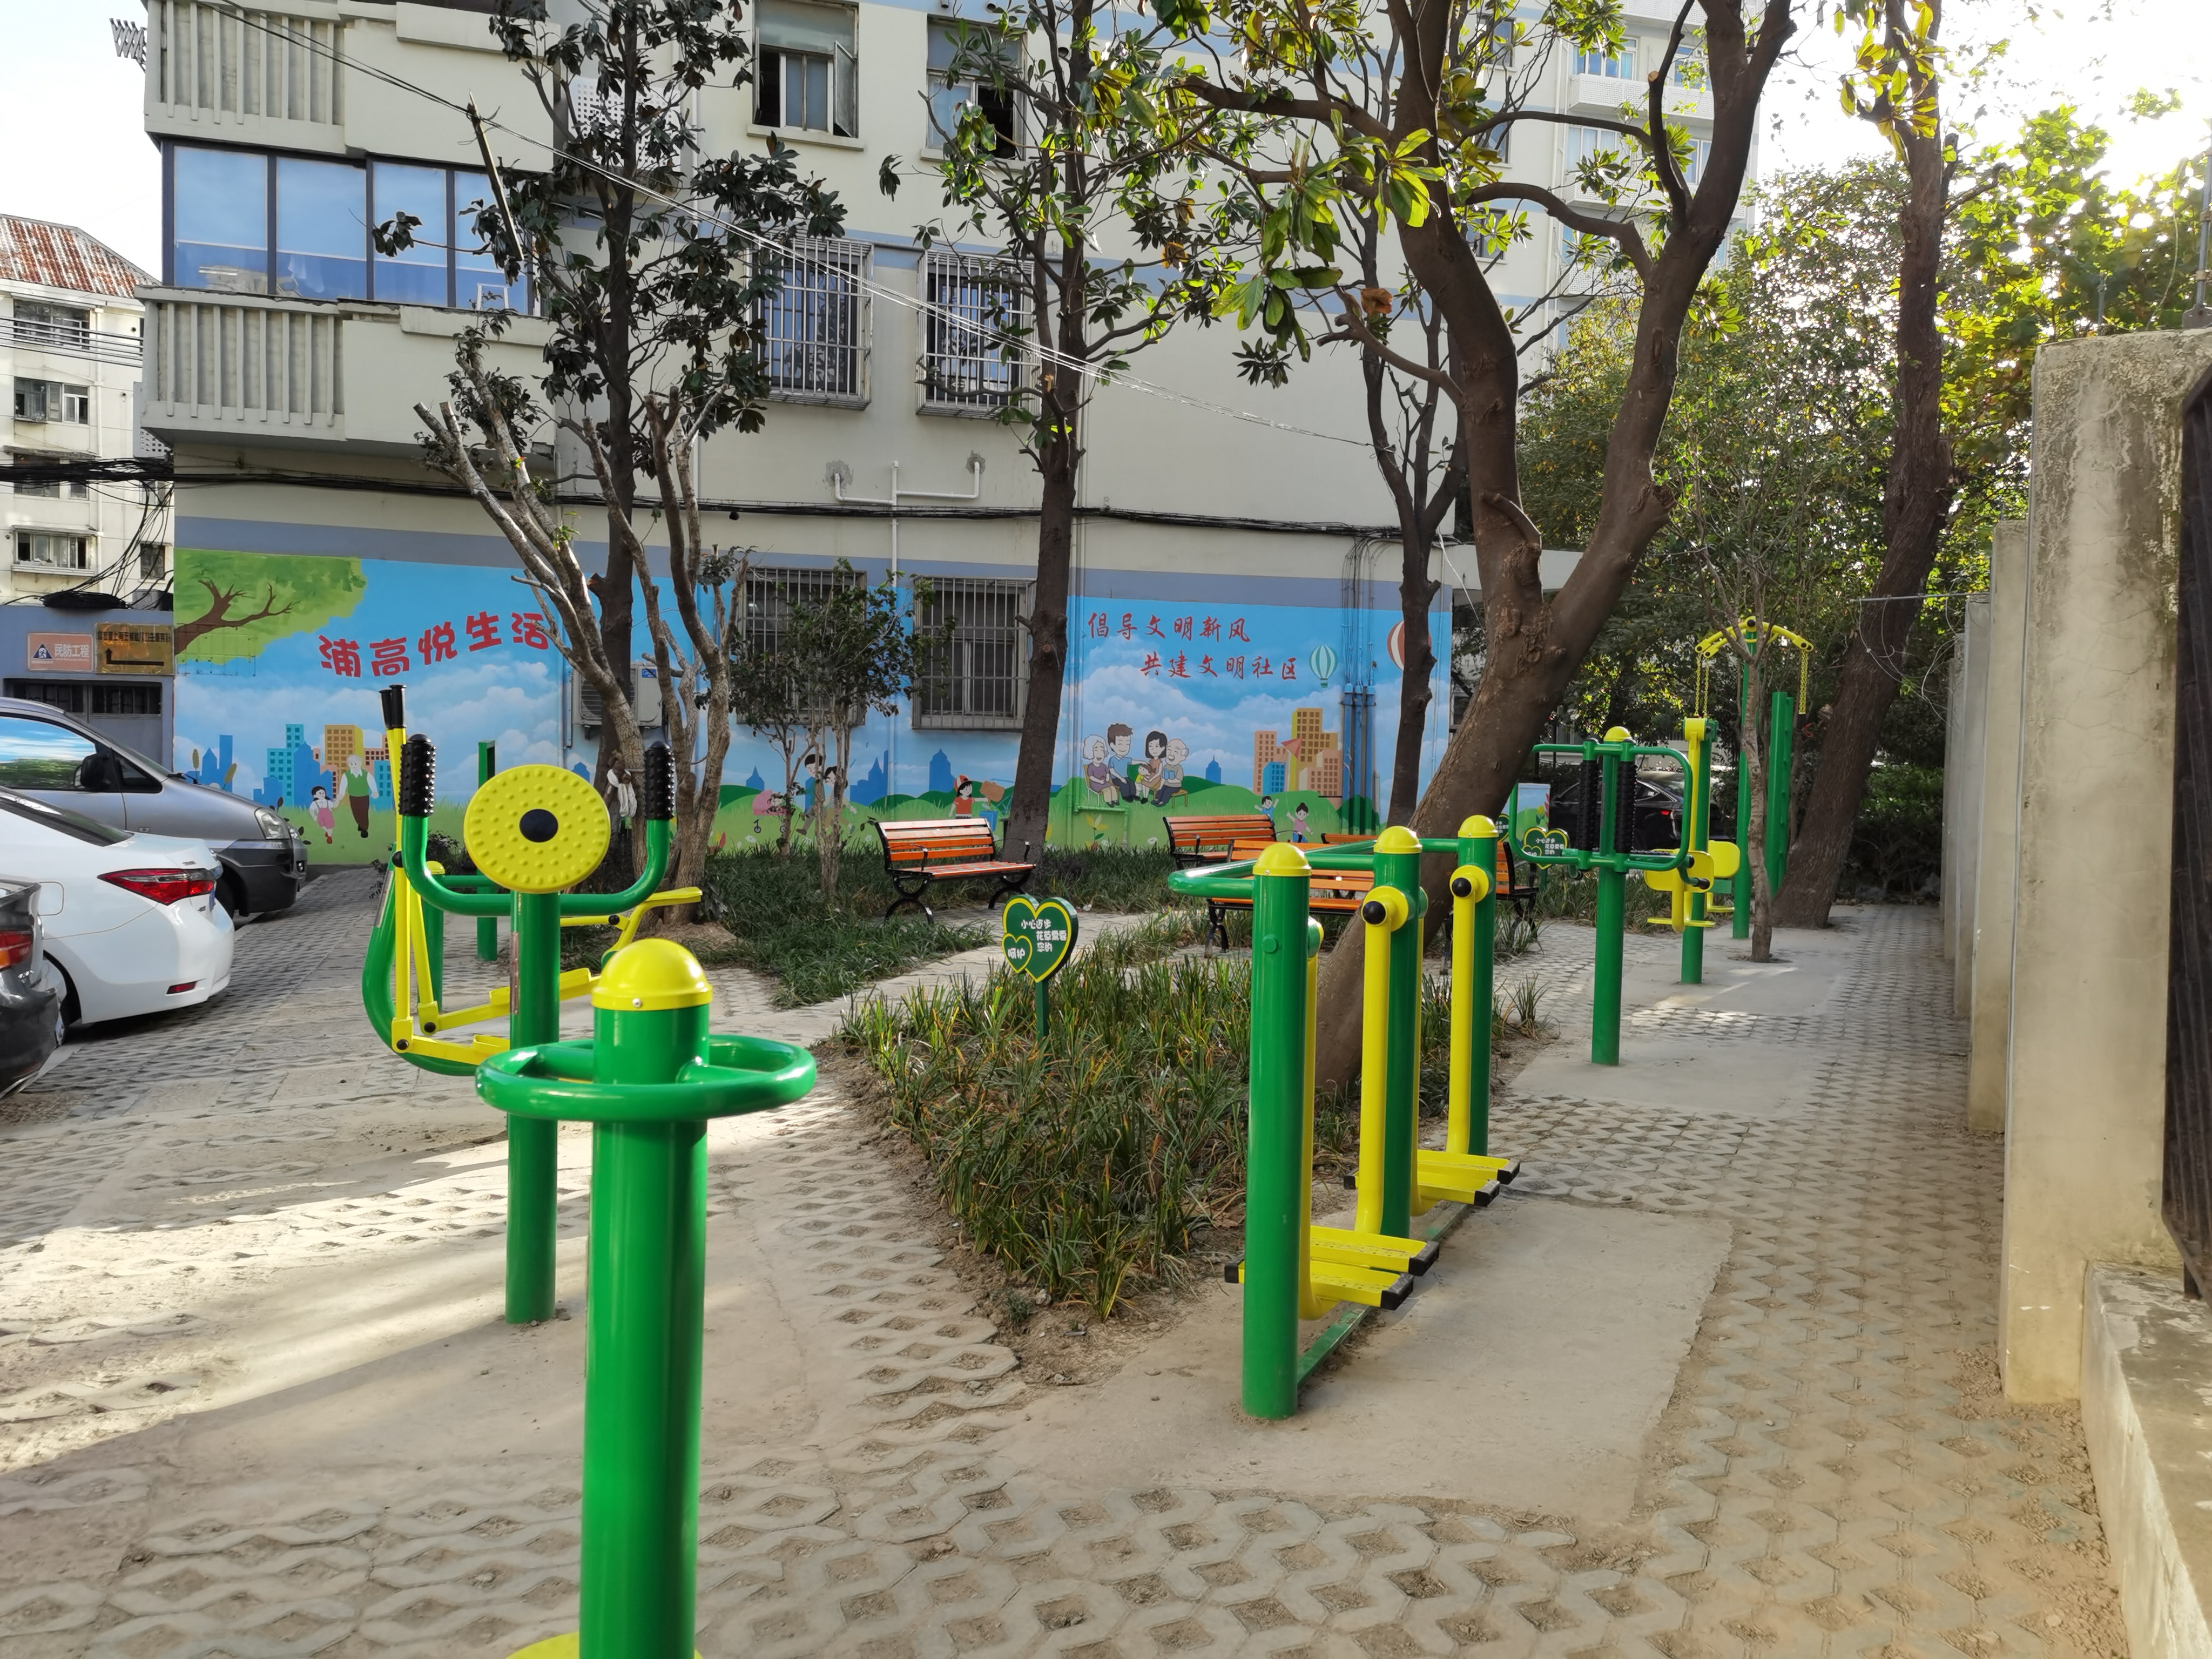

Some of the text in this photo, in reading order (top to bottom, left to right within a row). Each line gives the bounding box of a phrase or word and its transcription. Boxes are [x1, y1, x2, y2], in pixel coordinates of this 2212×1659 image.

[1087, 612, 1251, 643] 倡导文明新风
[55, 643, 90, 658] 民防工程
[318, 611, 549, 678] 浦高悦生活
[1139, 650, 1297, 680] 共建文明社区
[1021, 919, 1051, 929] 小心迈步
[1035, 930, 1067, 941] 花草需要
[1036, 942, 1053, 952] 您的
[1007, 948, 1026, 960] 呵护
